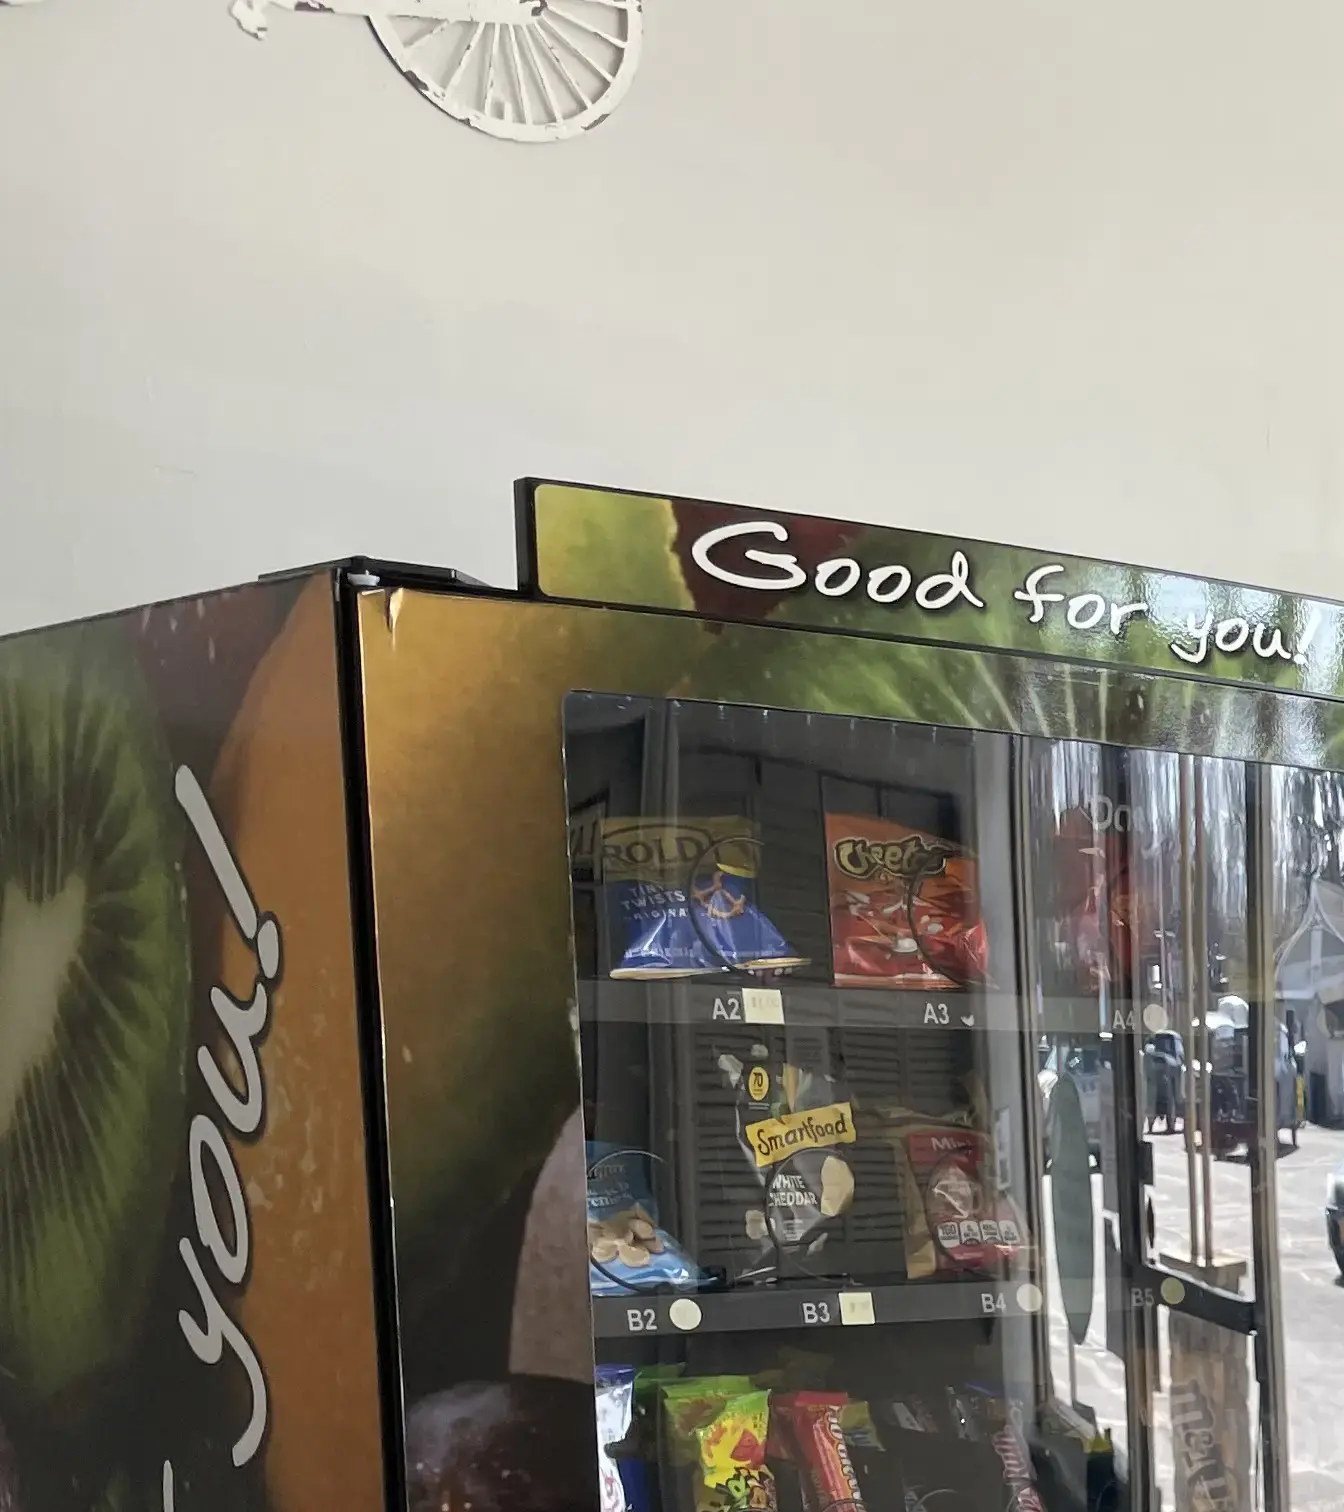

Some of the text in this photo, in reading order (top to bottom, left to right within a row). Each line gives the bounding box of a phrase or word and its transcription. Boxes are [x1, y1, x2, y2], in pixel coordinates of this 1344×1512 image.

[692, 519, 1320, 665] Good for you!
[712, 998, 741, 1020] A2
[923, 1003, 950, 1024] A3
[1112, 1009, 1135, 1030] A4
[174, 764, 281, 1467] you!
[757, 1112, 848, 1157] Smartfood
[772, 1175, 805, 1189] WHITE
[627, 1308, 657, 1332] B2
[803, 1302, 831, 1324] B3
[981, 1294, 1006, 1313] B4
